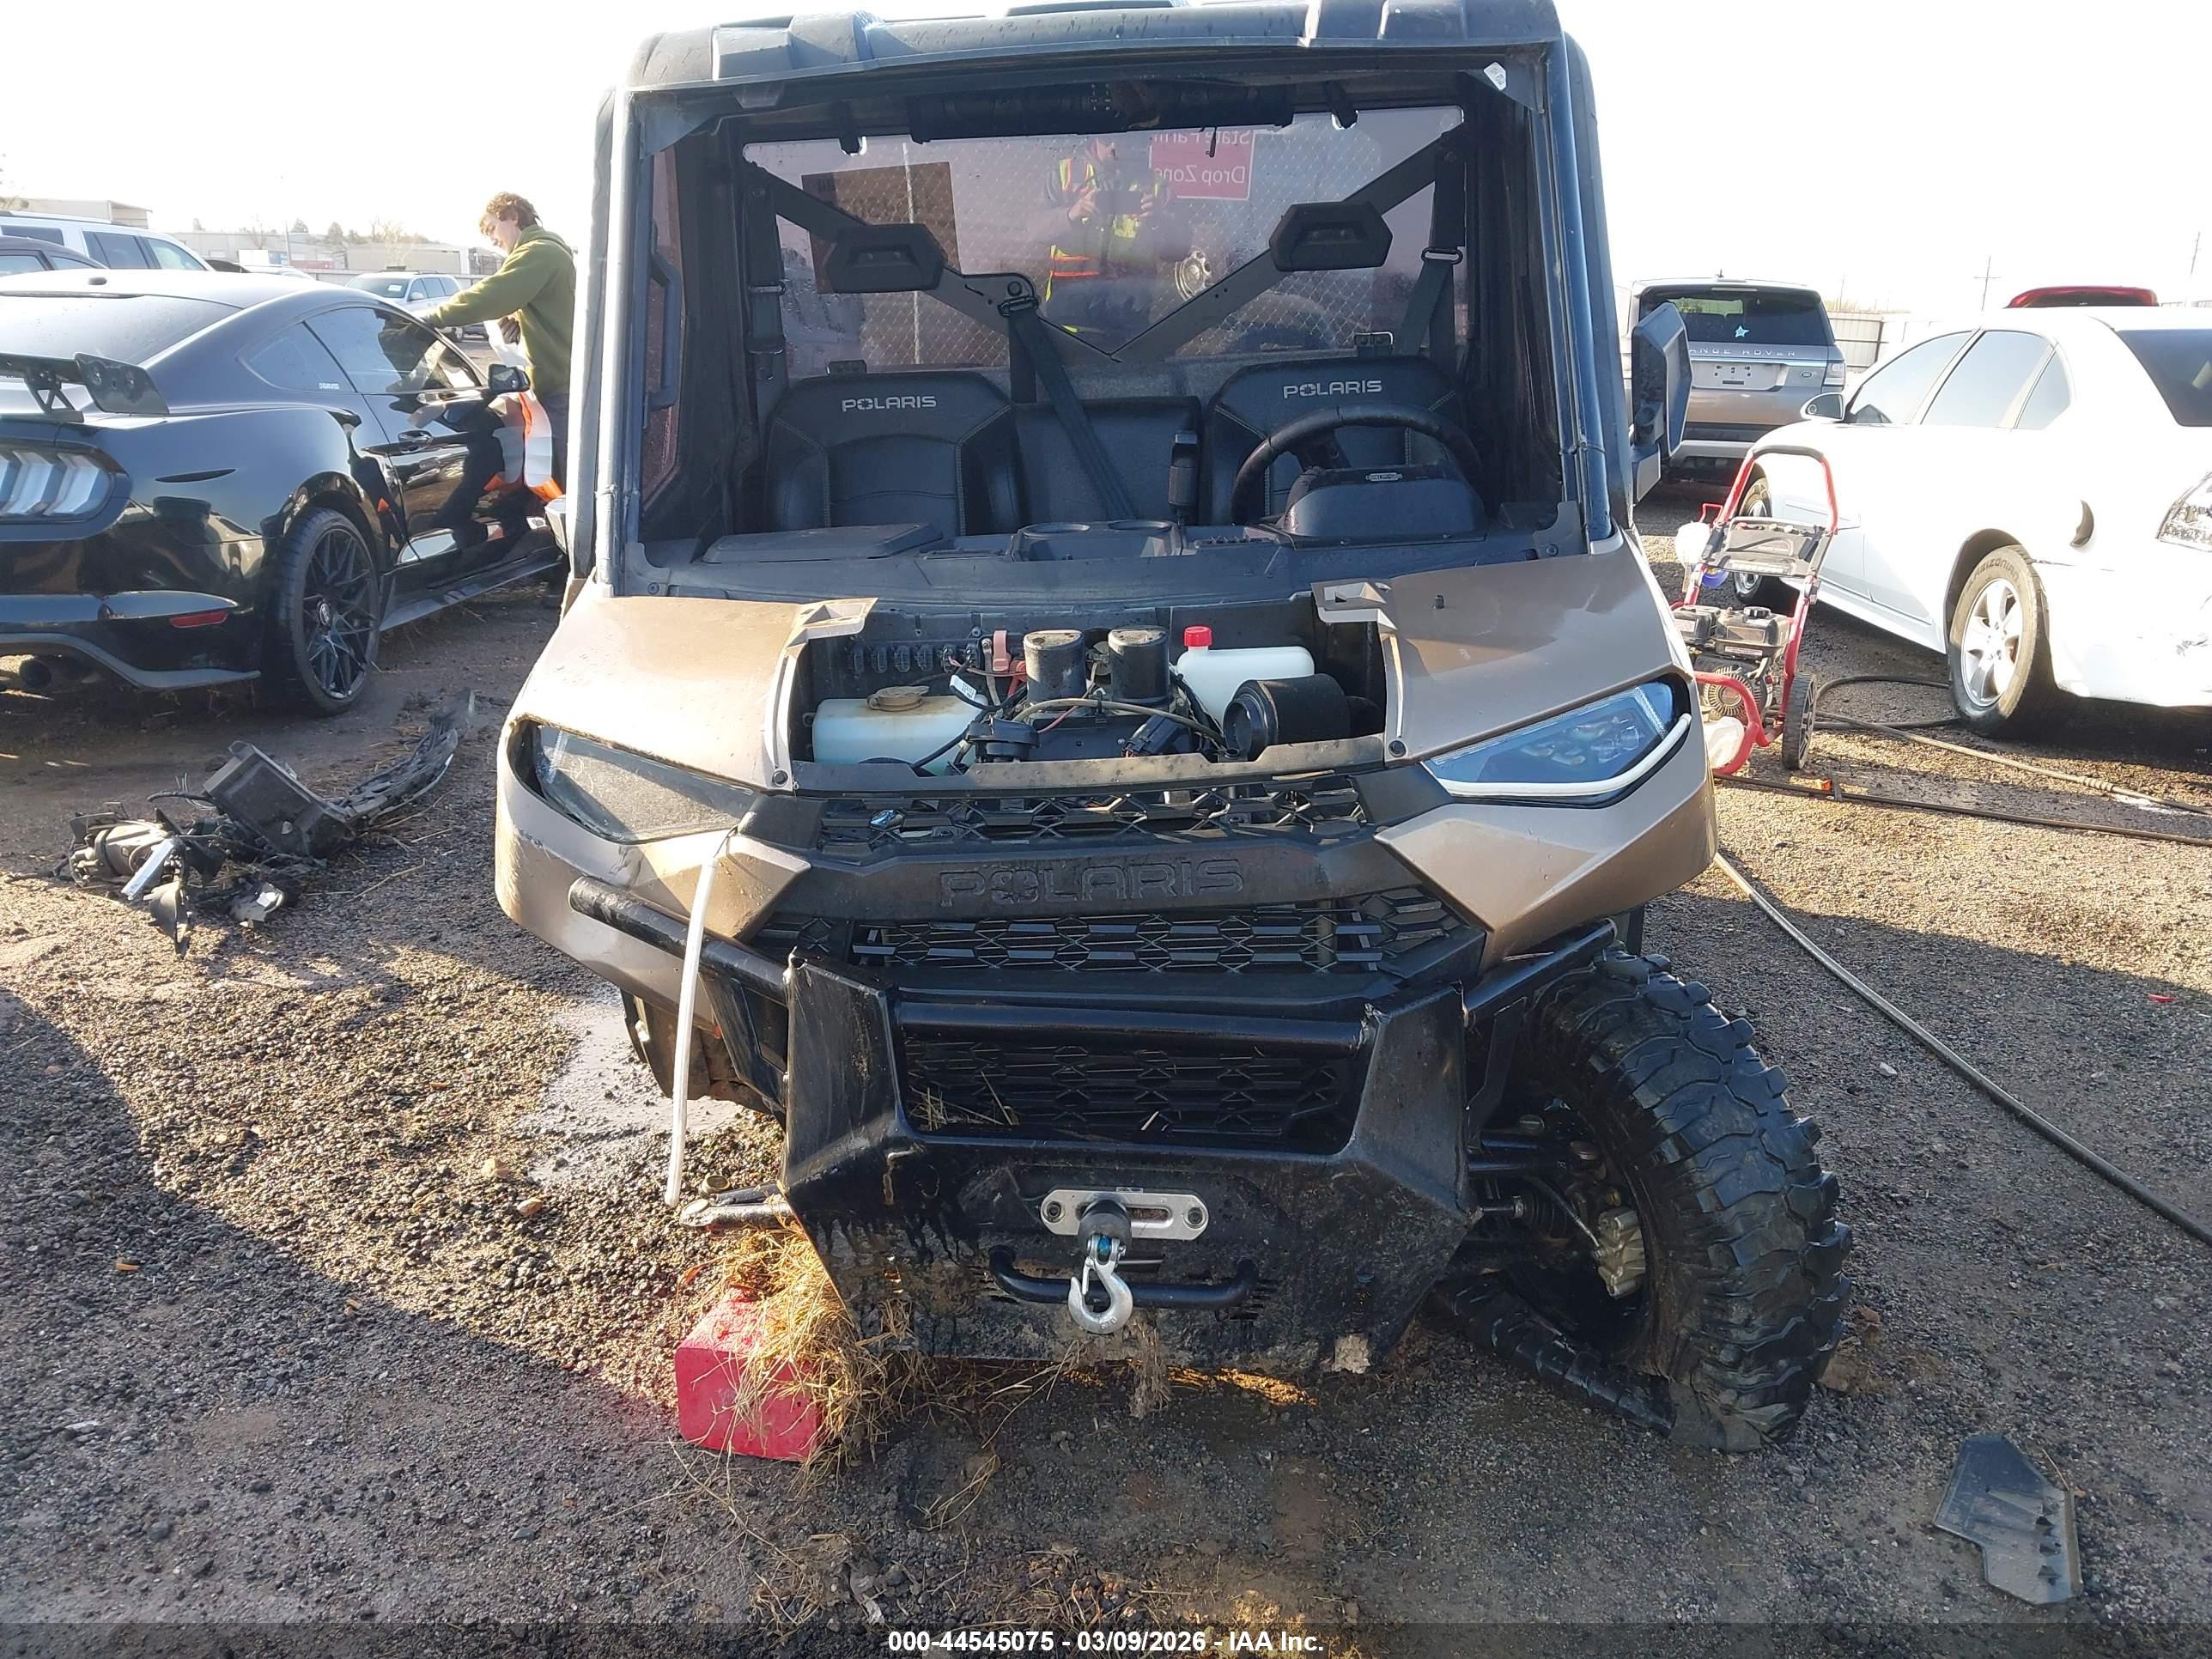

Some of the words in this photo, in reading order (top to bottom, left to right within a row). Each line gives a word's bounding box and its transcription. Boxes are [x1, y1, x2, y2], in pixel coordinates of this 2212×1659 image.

[1283, 380, 1382, 399] POLARIS
[842, 395, 937, 412] POLARIS
[940, 859, 1243, 907] POLARIS
